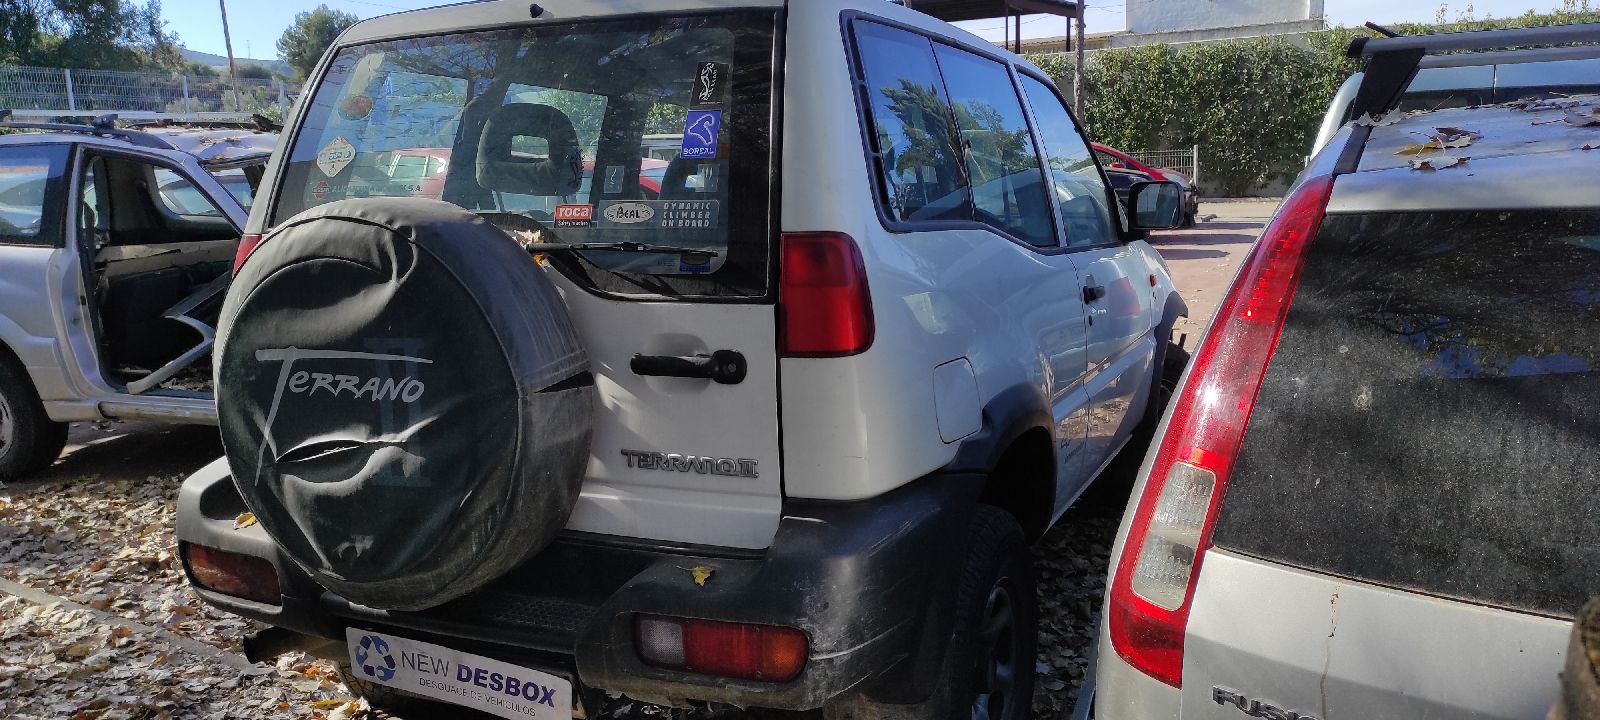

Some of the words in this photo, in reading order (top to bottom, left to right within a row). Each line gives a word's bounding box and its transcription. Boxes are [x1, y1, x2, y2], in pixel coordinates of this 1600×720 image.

[683, 147, 714, 155] BOREAL
[663, 202, 711, 210] DYNAMIC
[559, 207, 589, 217] roca
[616, 206, 640, 219] BEAL
[663, 211, 711, 219] CLIMBER
[661, 219, 675, 227] ON
[678, 219, 710, 227] BOARD
[621, 449, 736, 476] TERRANO
[738, 457, 759, 478] II
[401, 650, 449, 677] NEW
[456, 663, 557, 708] DESBOX
[419, 677, 469, 698] DESGUACE
[470, 690, 483, 702] DE
